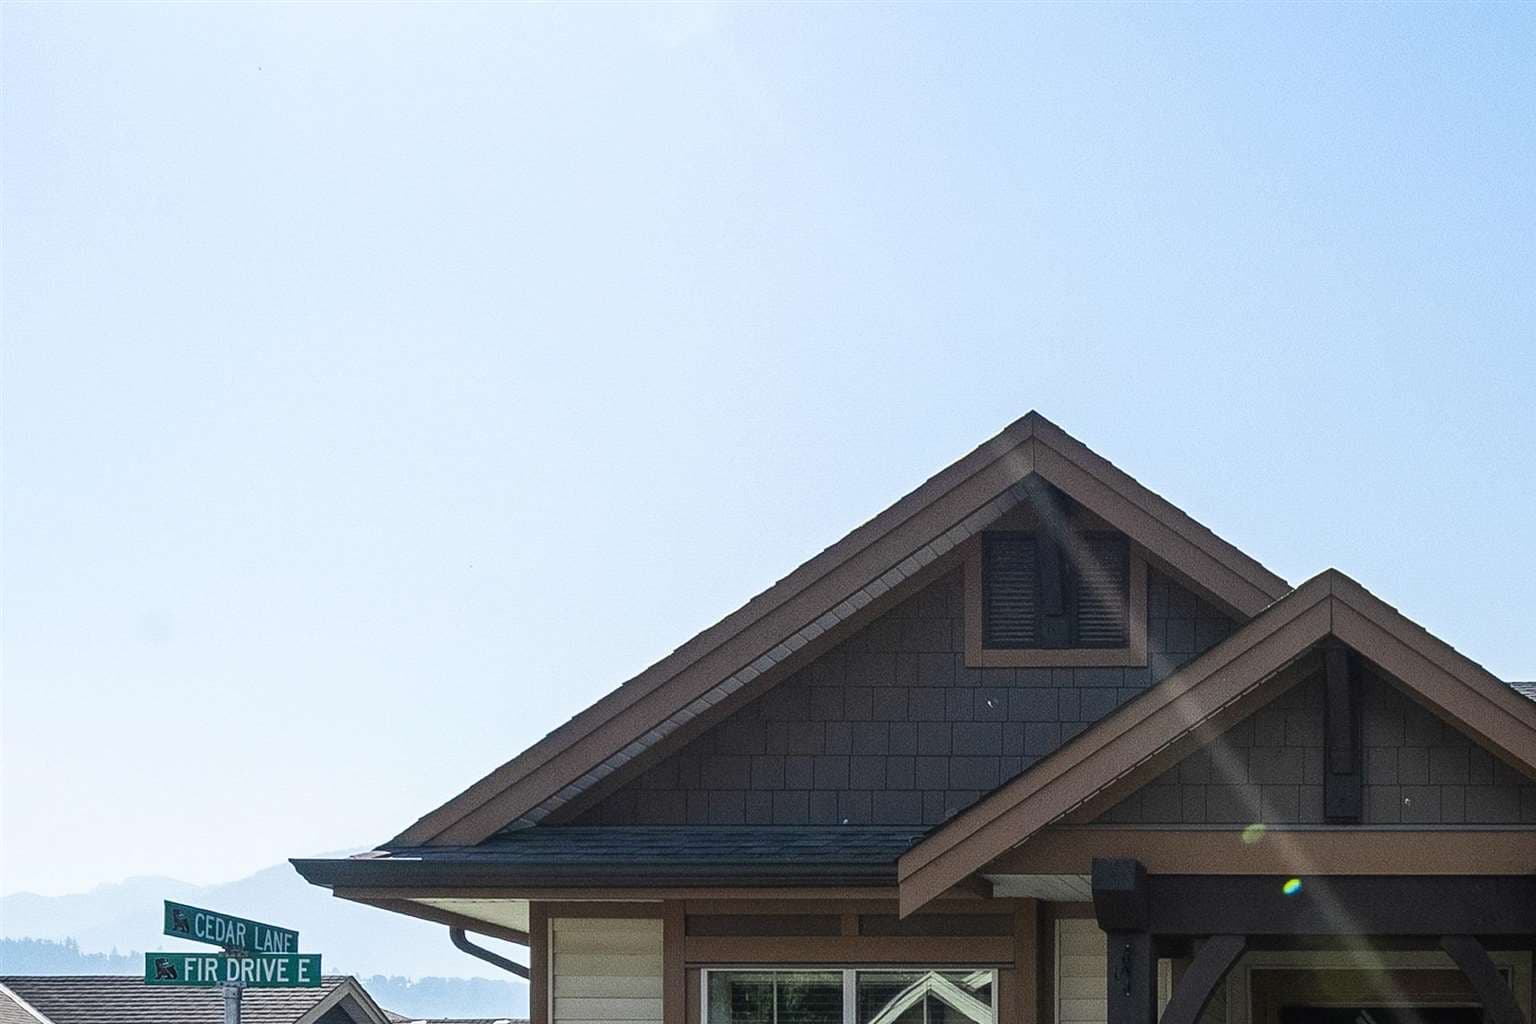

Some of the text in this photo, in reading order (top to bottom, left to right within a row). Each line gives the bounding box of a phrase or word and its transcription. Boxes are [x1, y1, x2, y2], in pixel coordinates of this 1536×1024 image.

[194, 913, 293, 953] CEDAR LANE
[184, 957, 311, 982] FIR DRIVE E
